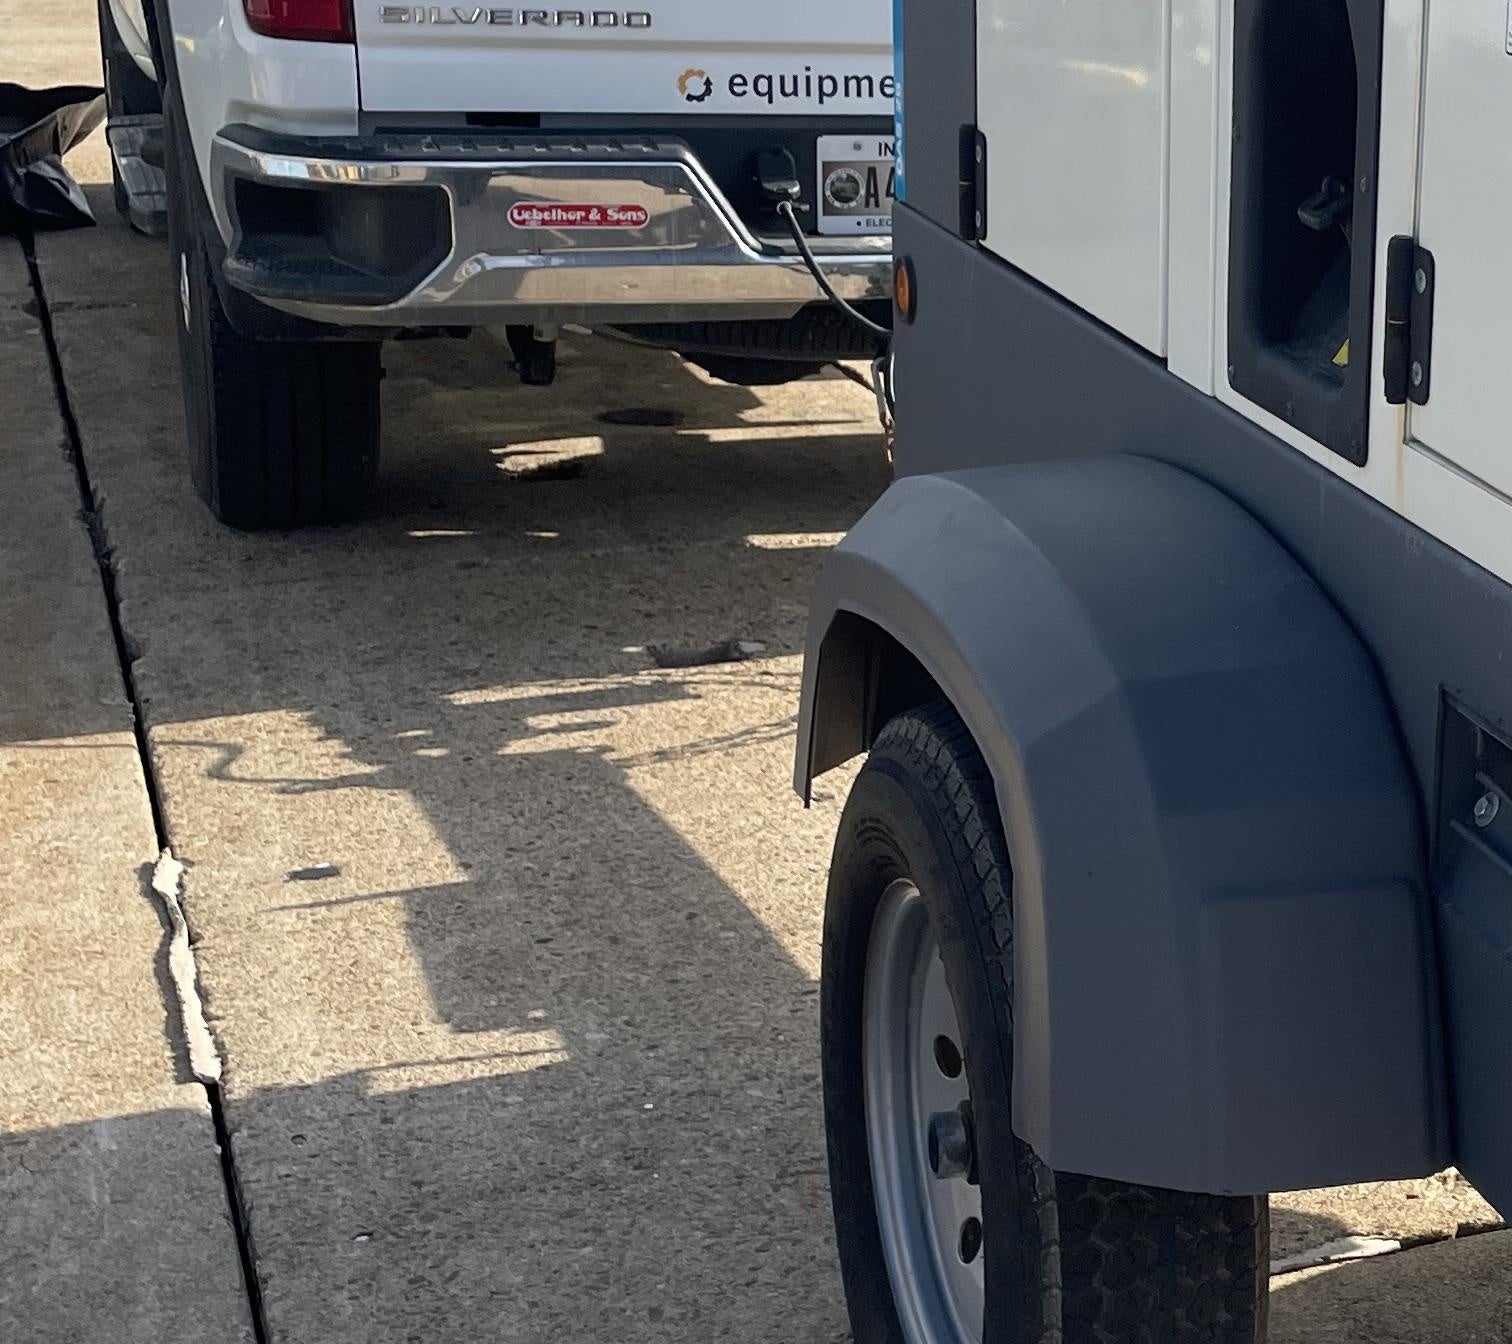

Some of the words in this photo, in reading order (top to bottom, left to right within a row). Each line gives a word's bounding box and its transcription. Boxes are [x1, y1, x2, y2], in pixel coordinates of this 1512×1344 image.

[379, 4, 652, 29] SILVERADO
[588, 208, 601, 221] &
[606, 208, 646, 222] Sons
